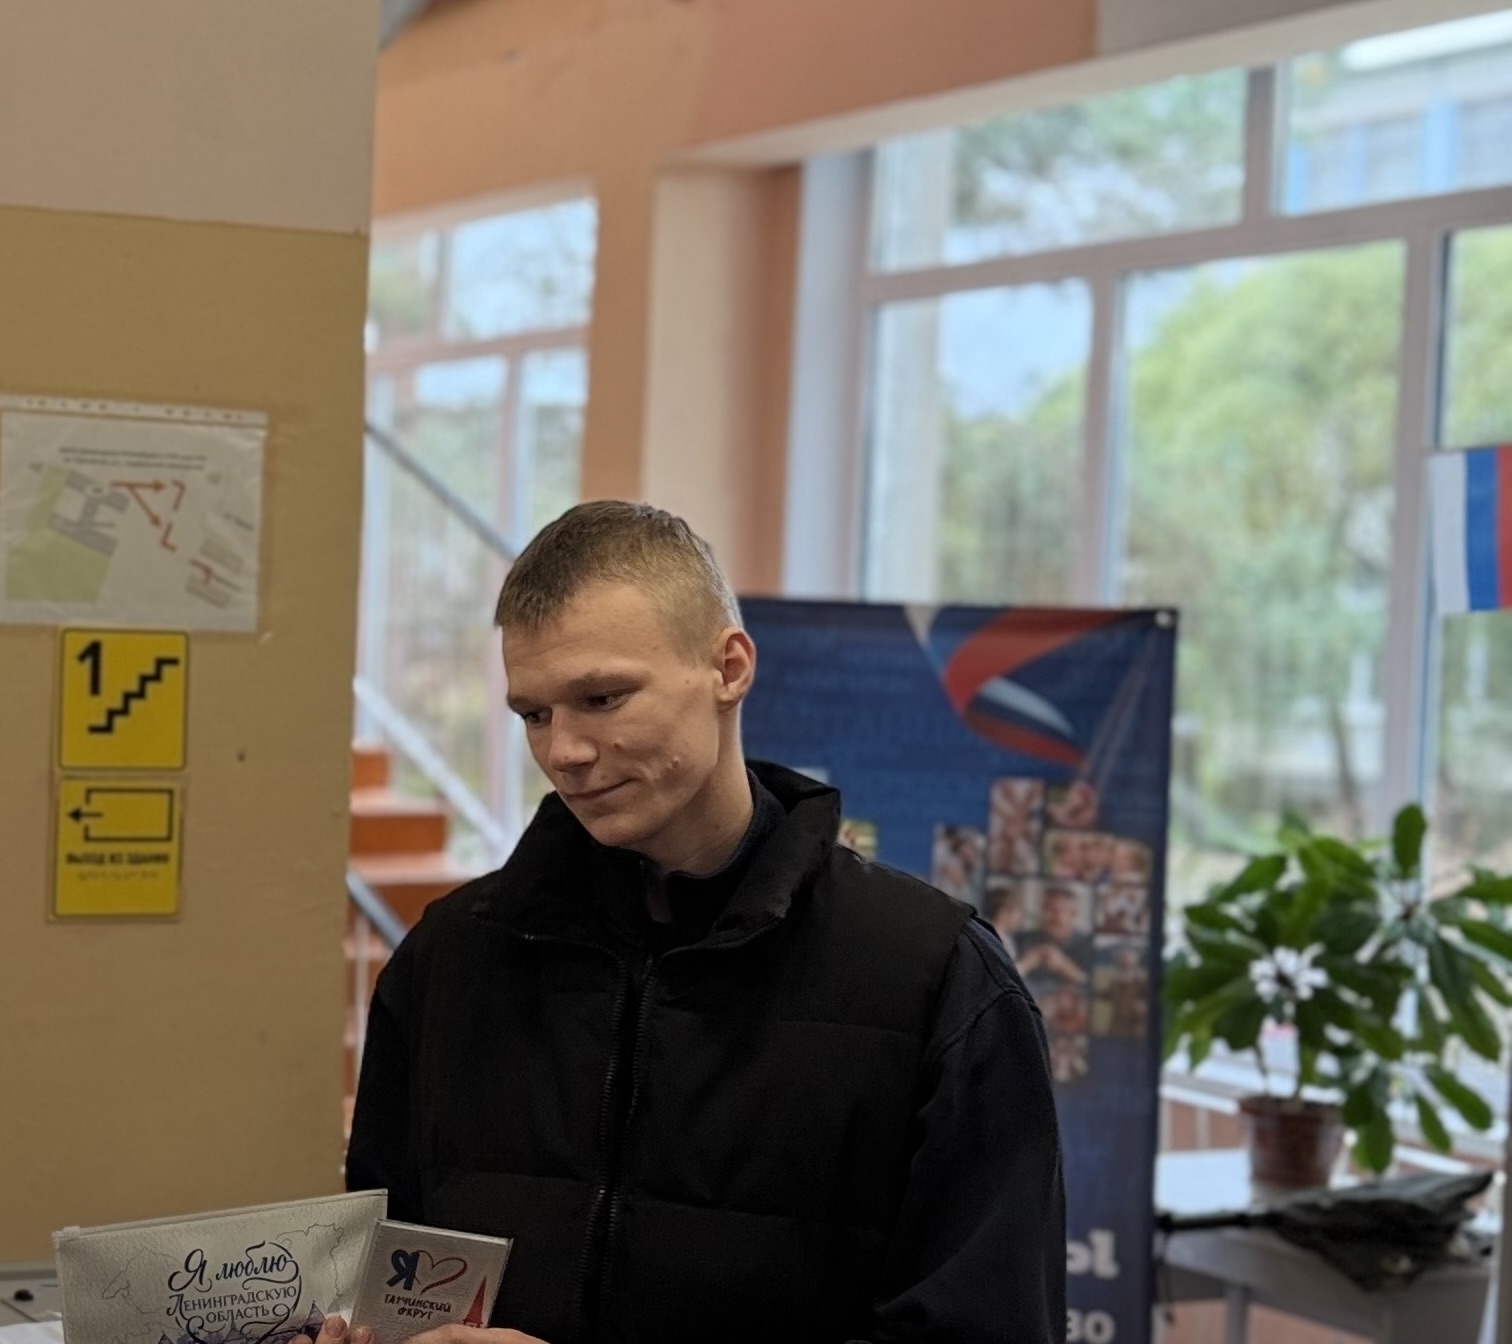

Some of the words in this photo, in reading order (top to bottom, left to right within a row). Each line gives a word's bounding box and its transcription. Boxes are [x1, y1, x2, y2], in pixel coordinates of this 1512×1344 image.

[78, 641, 101, 696] 1
[168, 1249, 212, 1292] Я
[215, 1240, 296, 1283] люблю
[386, 1249, 420, 1291] Я
[166, 1285, 297, 1320] ЛЕНИНГРАДСКУЮ
[206, 1305, 270, 1324] ОБЛАСТЬ
[385, 1294, 451, 1313] ГАТЧИНСКИЙ
[398, 1306, 433, 1320] ОКРУГ
